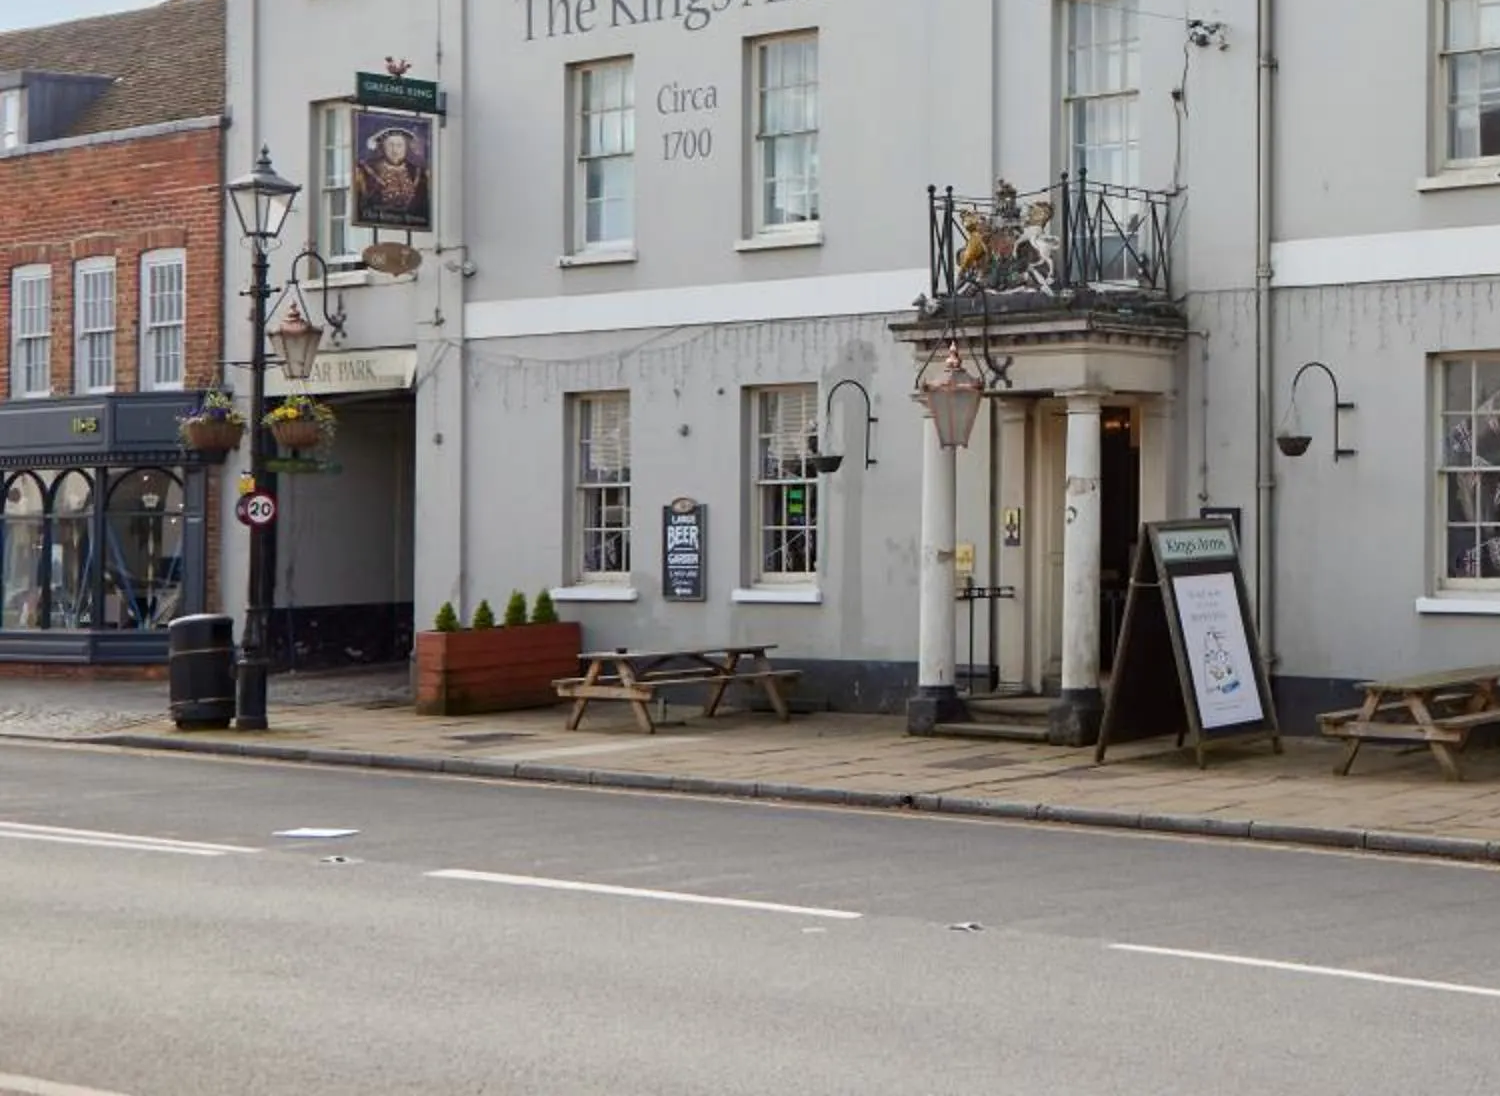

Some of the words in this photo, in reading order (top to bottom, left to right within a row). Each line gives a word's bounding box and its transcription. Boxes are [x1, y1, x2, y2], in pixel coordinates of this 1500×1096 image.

[656, 82, 718, 115] Circa
[663, 128, 712, 161] 1700
[313, 361, 332, 383] AR
[339, 359, 376, 382] PARK
[249, 502, 272, 516] 20
[667, 525, 699, 553] BEER
